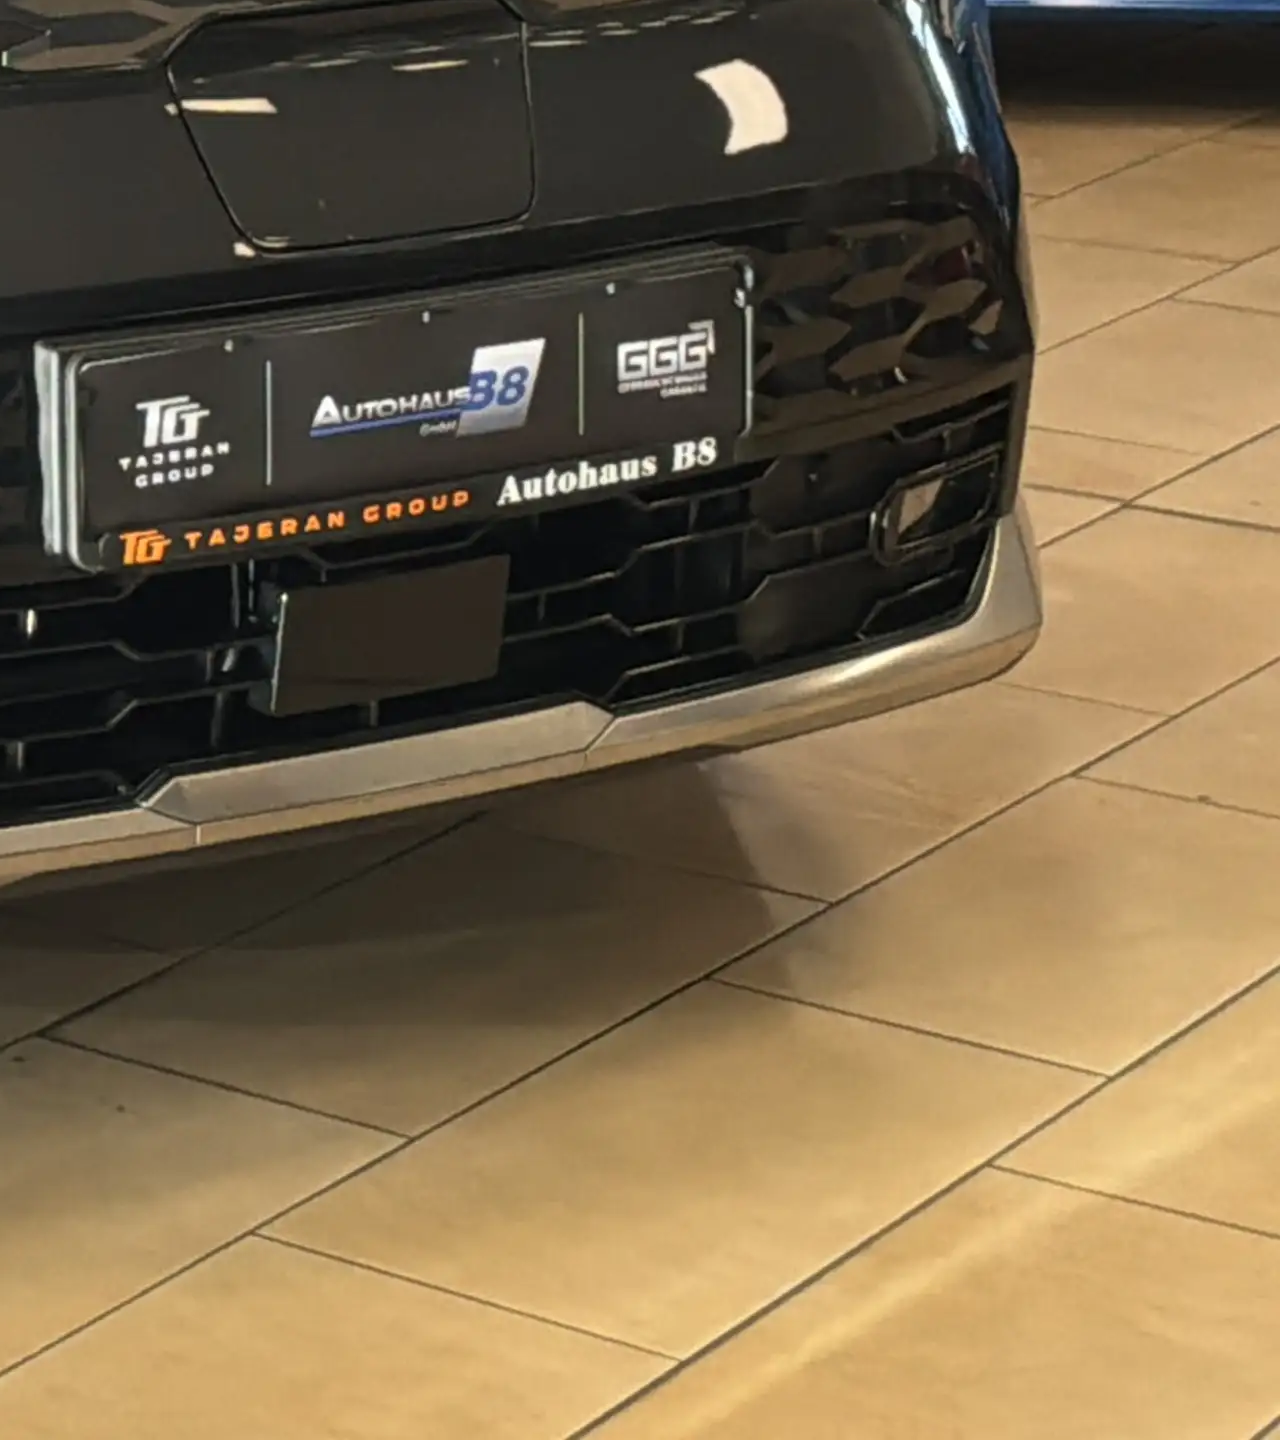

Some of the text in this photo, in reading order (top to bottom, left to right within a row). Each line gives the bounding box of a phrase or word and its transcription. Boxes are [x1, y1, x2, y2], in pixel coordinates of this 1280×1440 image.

[617, 330, 709, 383] GGG
[118, 441, 231, 471] TAJERAN
[134, 463, 215, 489] GROUP
[183, 510, 346, 550] TAJERAN
[362, 489, 470, 524] GROUP
[495, 453, 658, 507] Autohaus
[670, 435, 718, 474] B8
